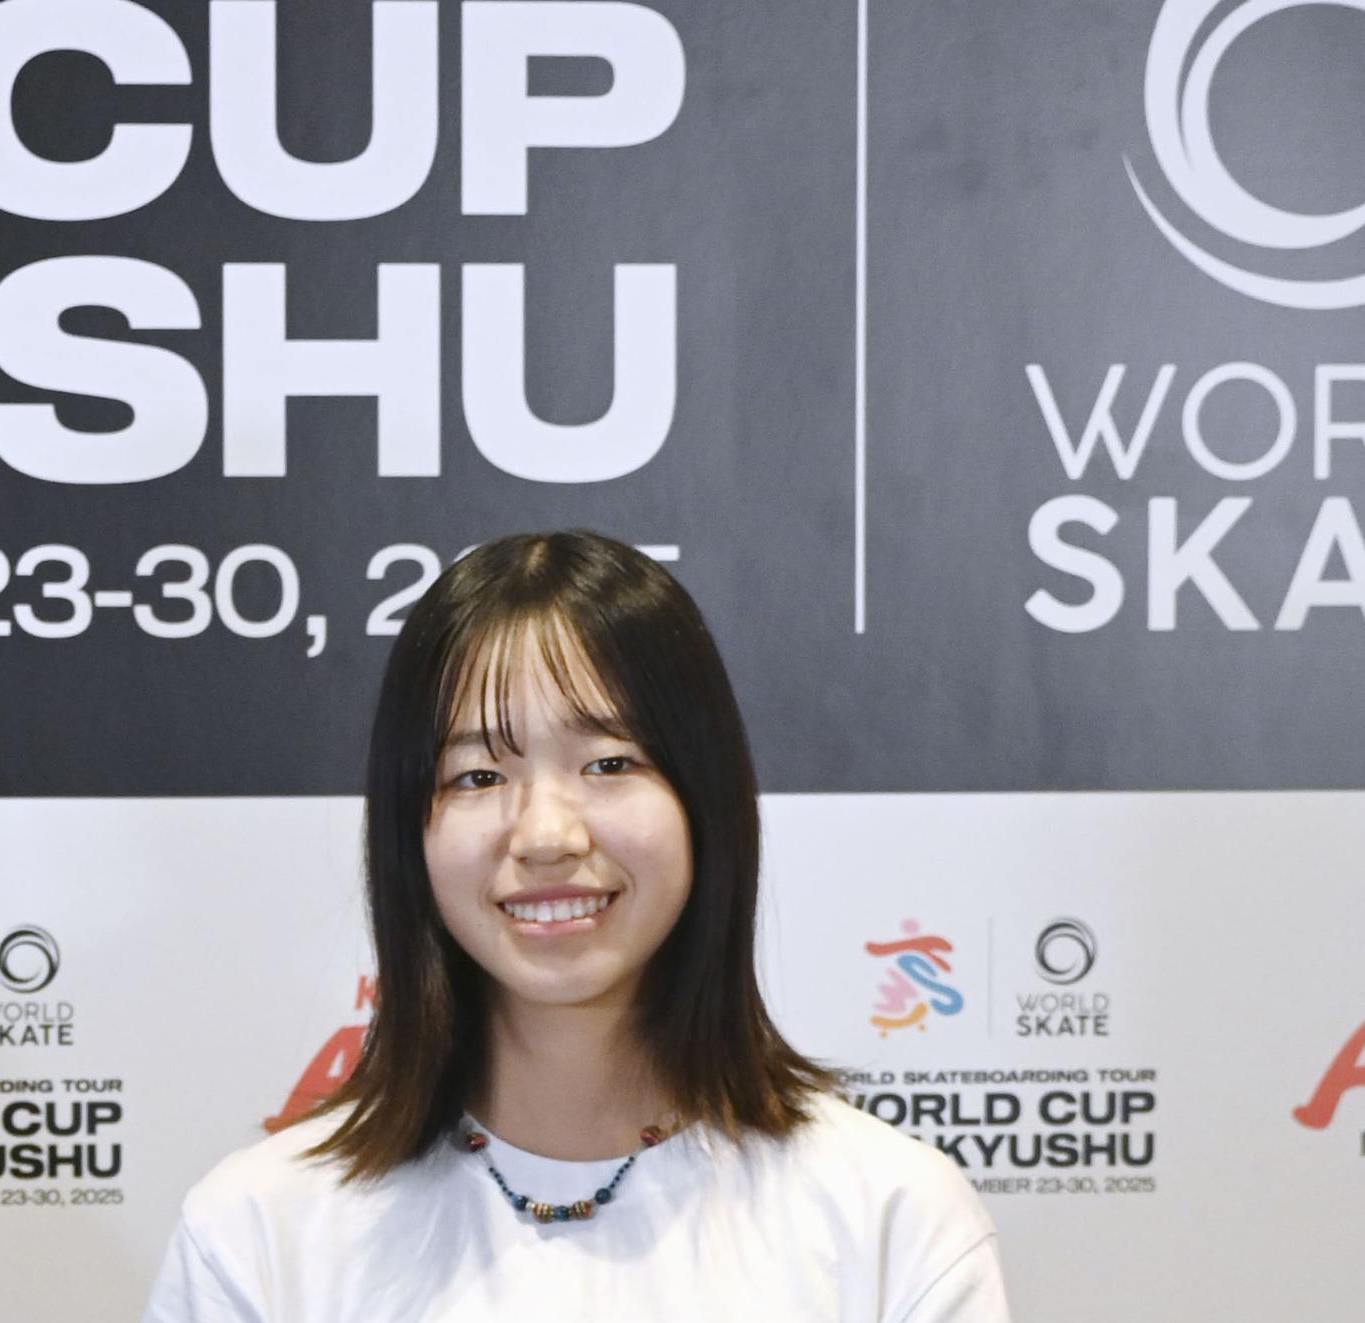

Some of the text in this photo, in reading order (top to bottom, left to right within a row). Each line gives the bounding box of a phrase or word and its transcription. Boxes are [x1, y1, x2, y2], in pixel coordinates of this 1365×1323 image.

[1016, 993, 1110, 1013] WORLD
[1017, 1014, 1110, 1037] SKATE
[62, 1079, 123, 1093] TOUR
[904, 1070, 1088, 1083] SKATEBOARDING
[1097, 1069, 1156, 1082] TOUR
[1039, 1091, 1156, 1125] CUP
[2, 1101, 123, 1137] CUP
[910, 1133, 1154, 1169] KYUSHU
[1, 1189, 64, 1208] 23-30,
[71, 1188, 124, 1205] 2025
